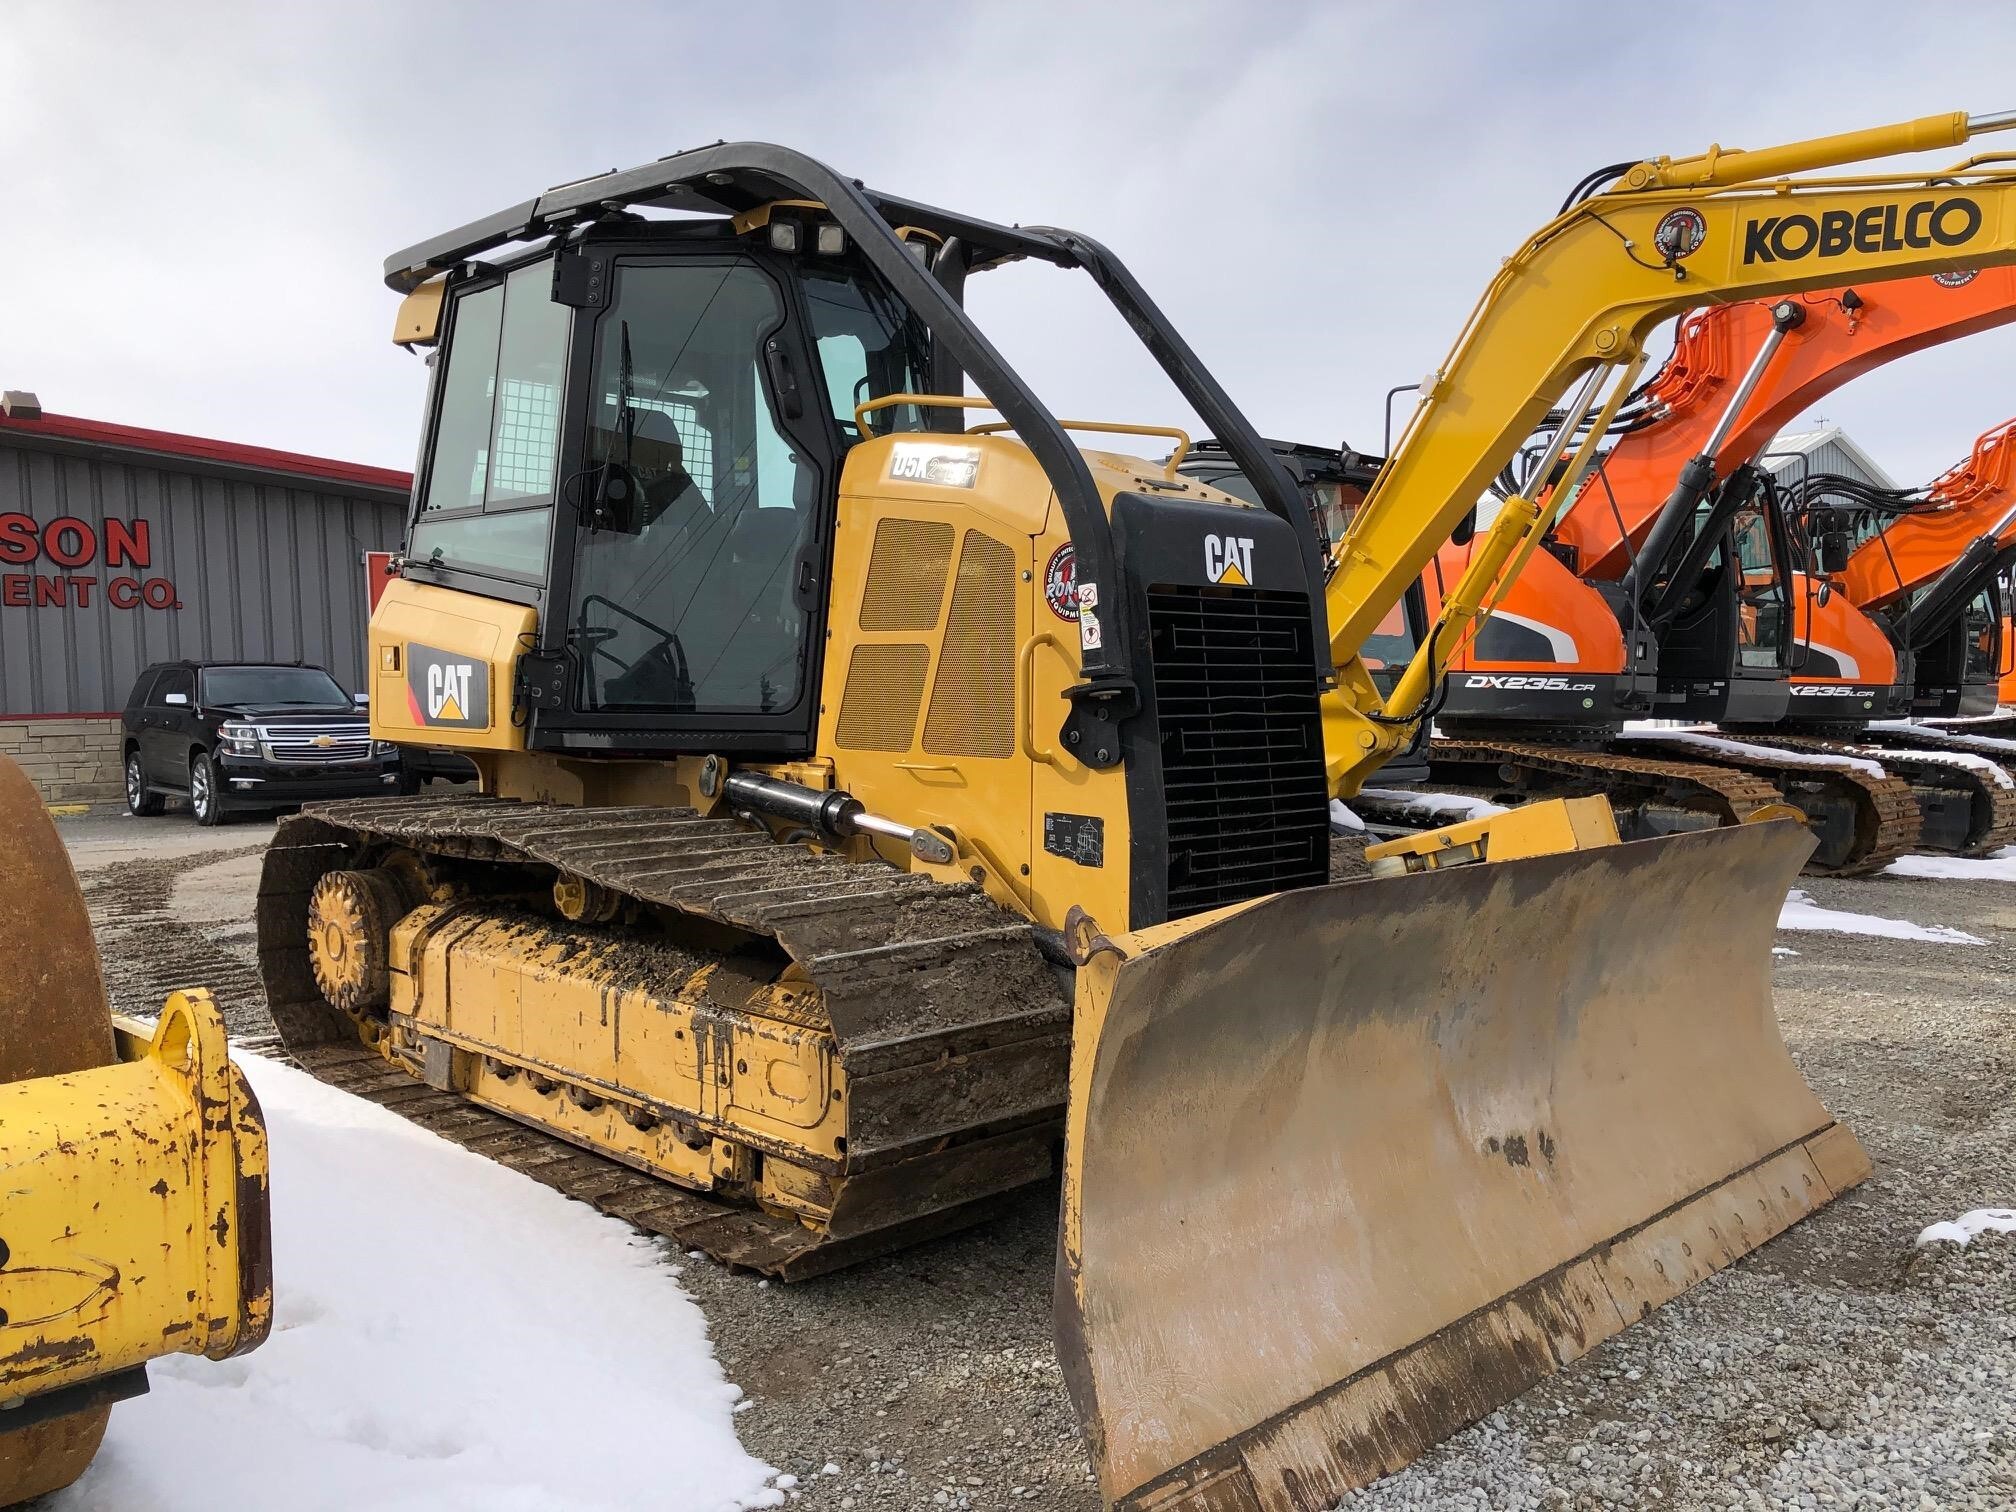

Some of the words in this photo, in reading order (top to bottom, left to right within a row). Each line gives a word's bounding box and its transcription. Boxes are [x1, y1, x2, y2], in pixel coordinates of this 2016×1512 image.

[1743, 198, 1983, 265] KOBELCO
[0, 512, 151, 568] SON
[1205, 534, 1254, 585] CAT
[3, 574, 97, 607] ENT
[108, 577, 183, 609] CO.
[1046, 580, 1078, 599] RON
[1047, 558, 1060, 583] QUALITY
[428, 664, 472, 720] CAT
